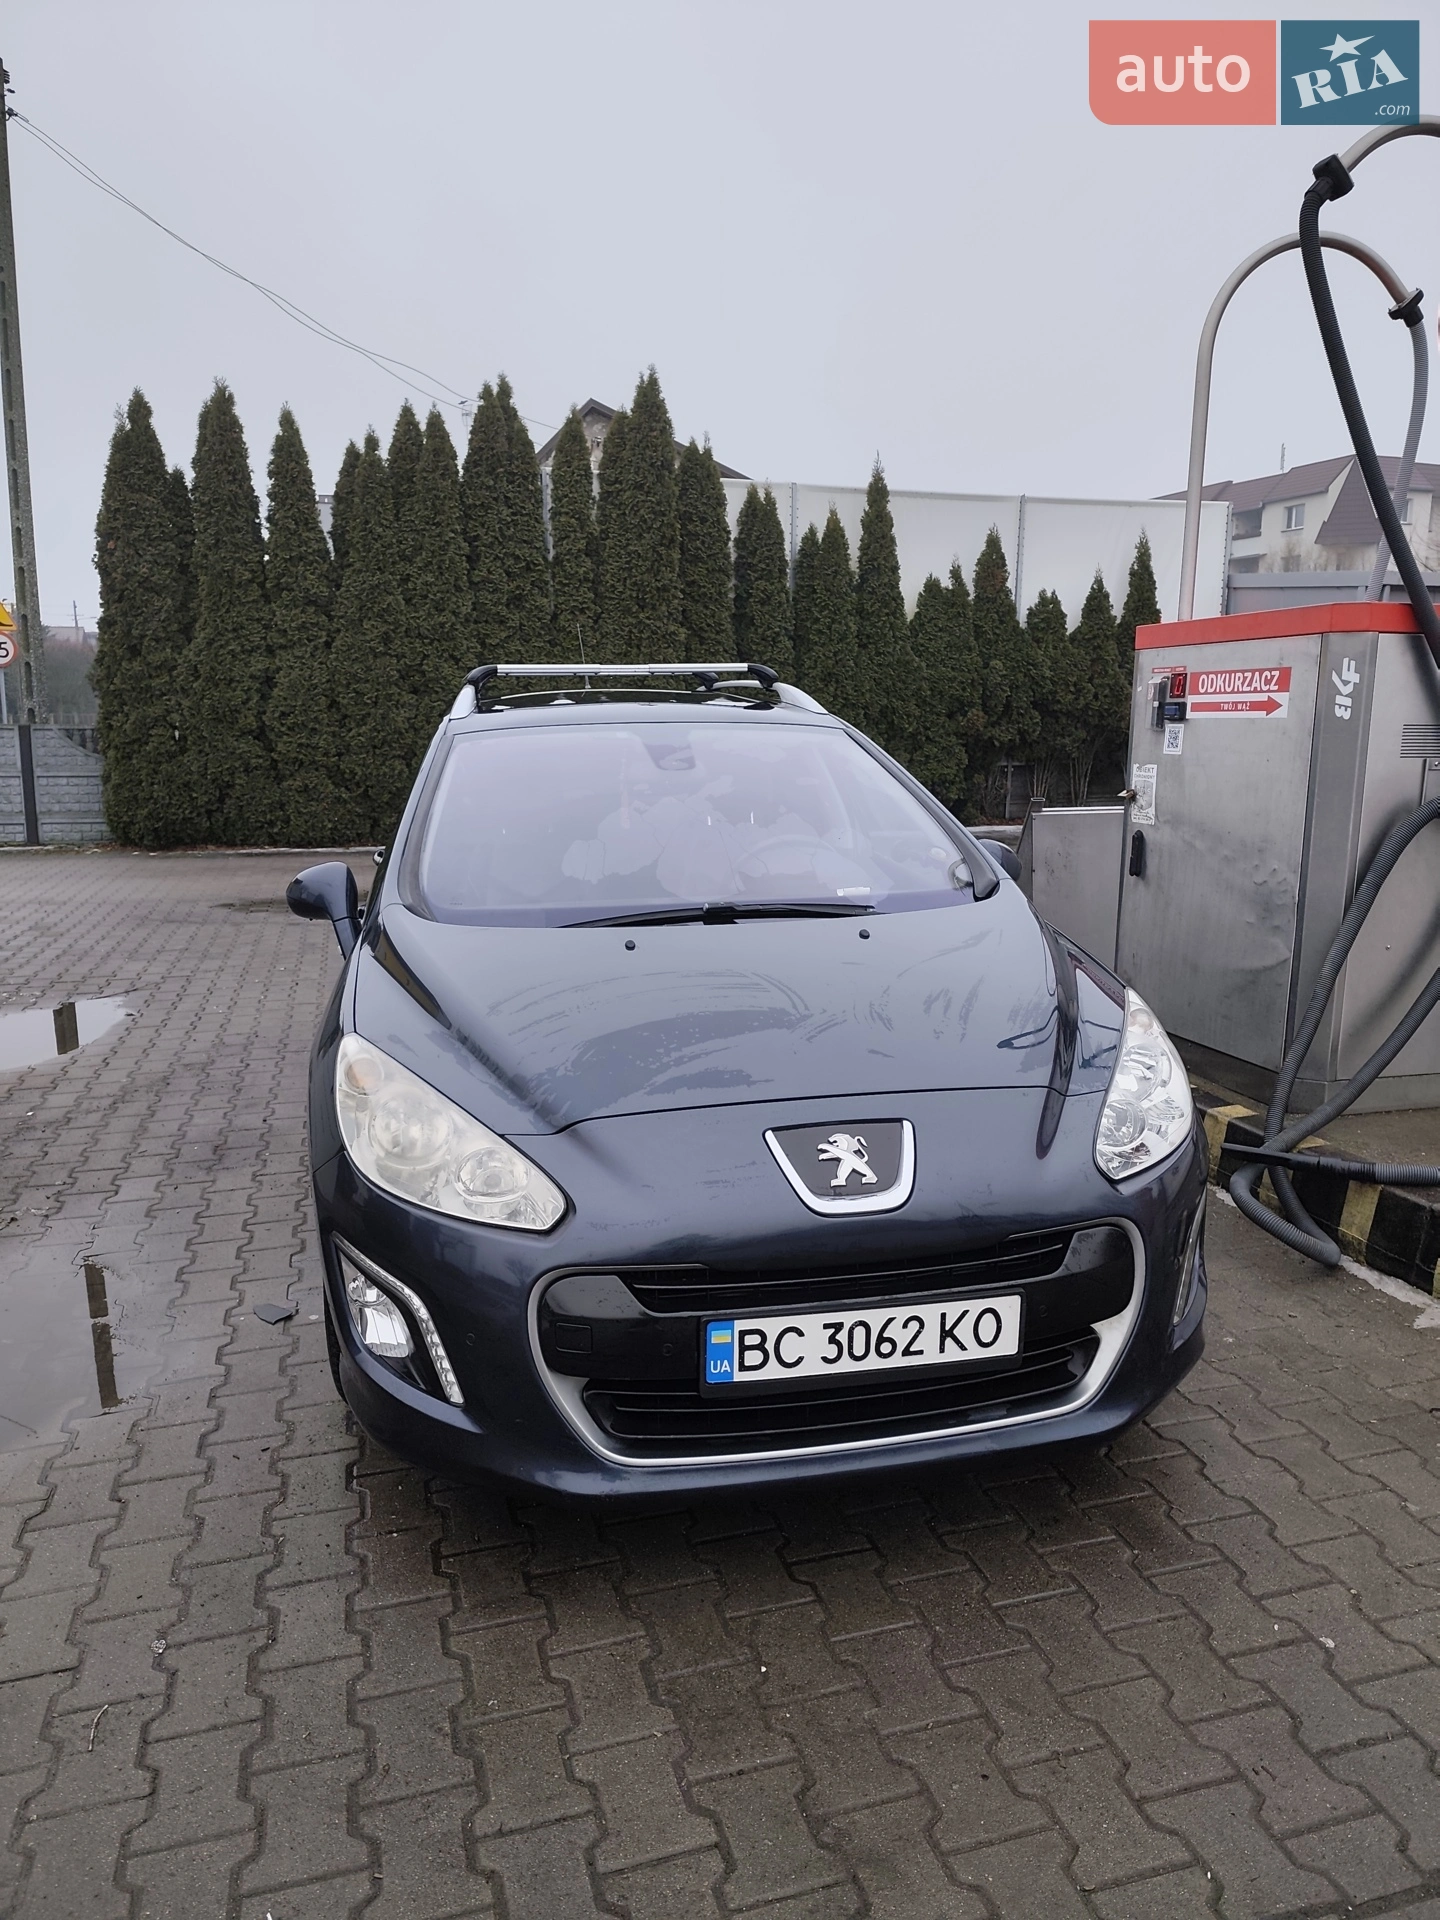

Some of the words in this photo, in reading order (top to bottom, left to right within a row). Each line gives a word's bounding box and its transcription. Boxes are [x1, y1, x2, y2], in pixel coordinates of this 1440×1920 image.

[1198, 670, 1280, 693] ODKURZACZ
[1238, 702, 1250, 711] WĄŻ
[738, 1325, 805, 1372] BC
[820, 1314, 925, 1364] 3062
[938, 1306, 1002, 1354] KO
[710, 1360, 731, 1373] UA
